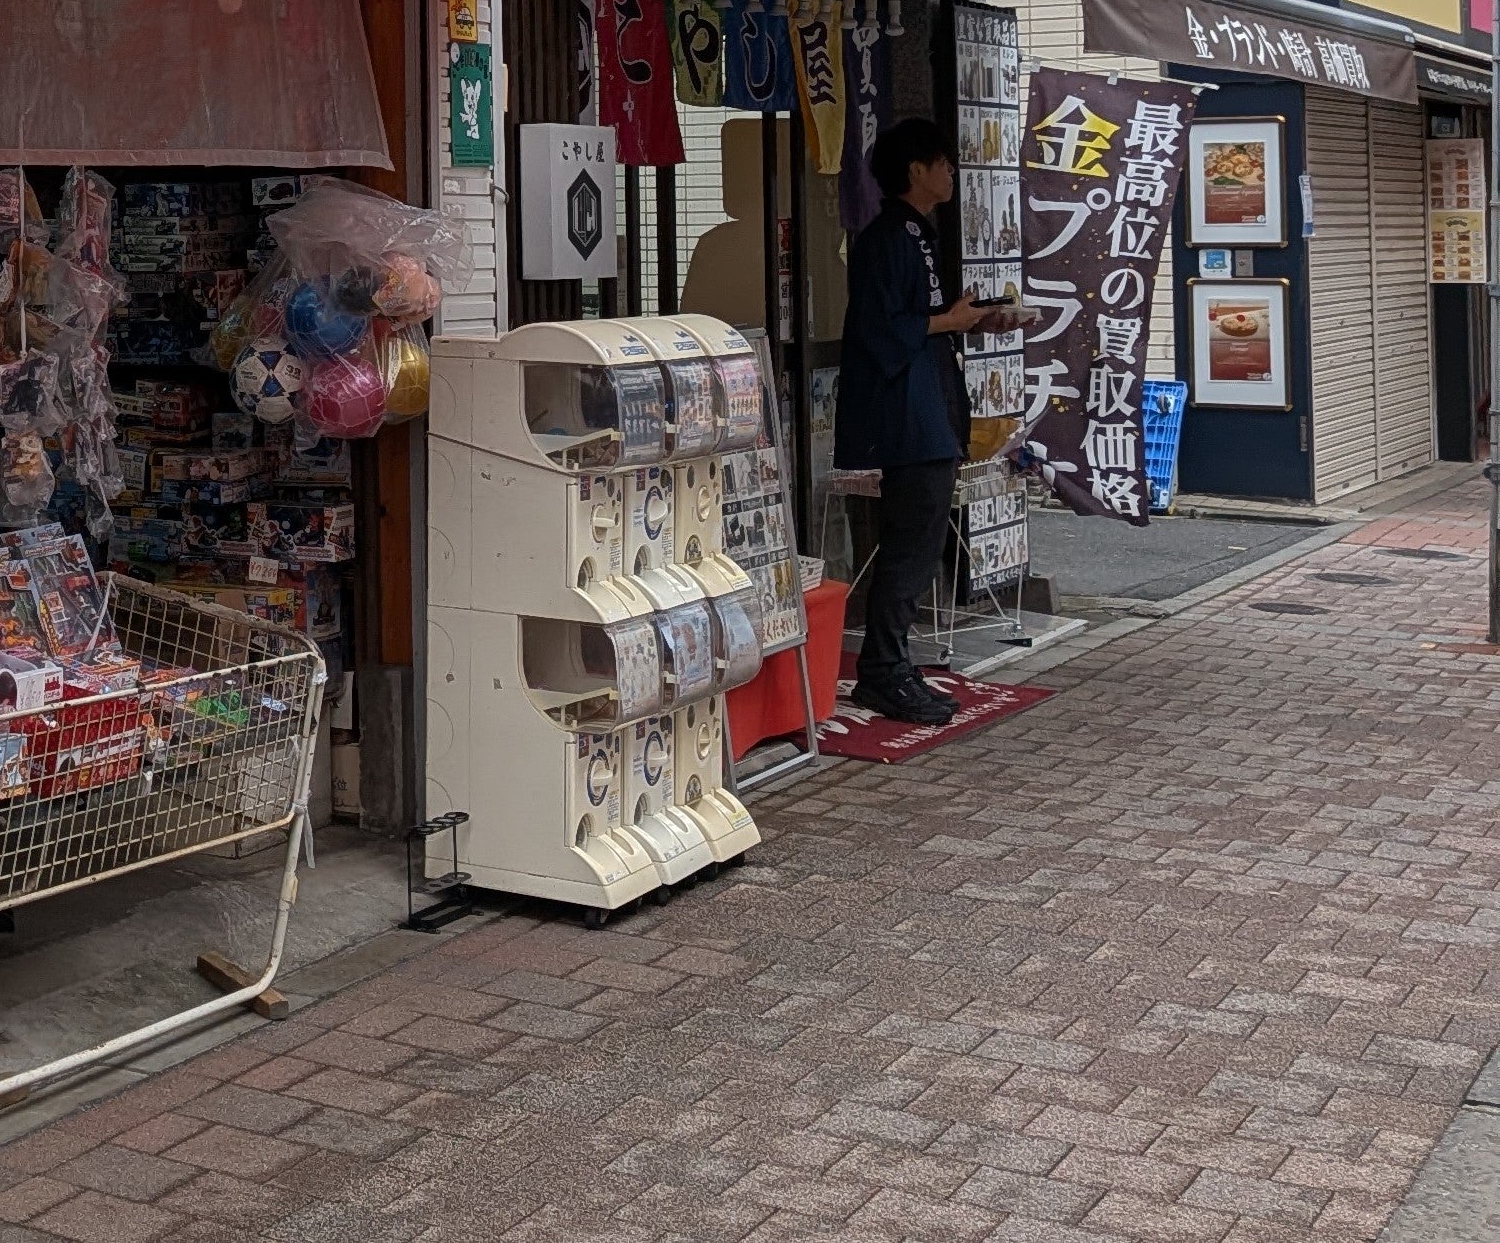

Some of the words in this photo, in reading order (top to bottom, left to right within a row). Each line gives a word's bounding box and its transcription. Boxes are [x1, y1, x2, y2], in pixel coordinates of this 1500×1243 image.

[561, 140, 605, 163] こやし屋
[1079, 100, 1184, 517] 最高位の買取価格
